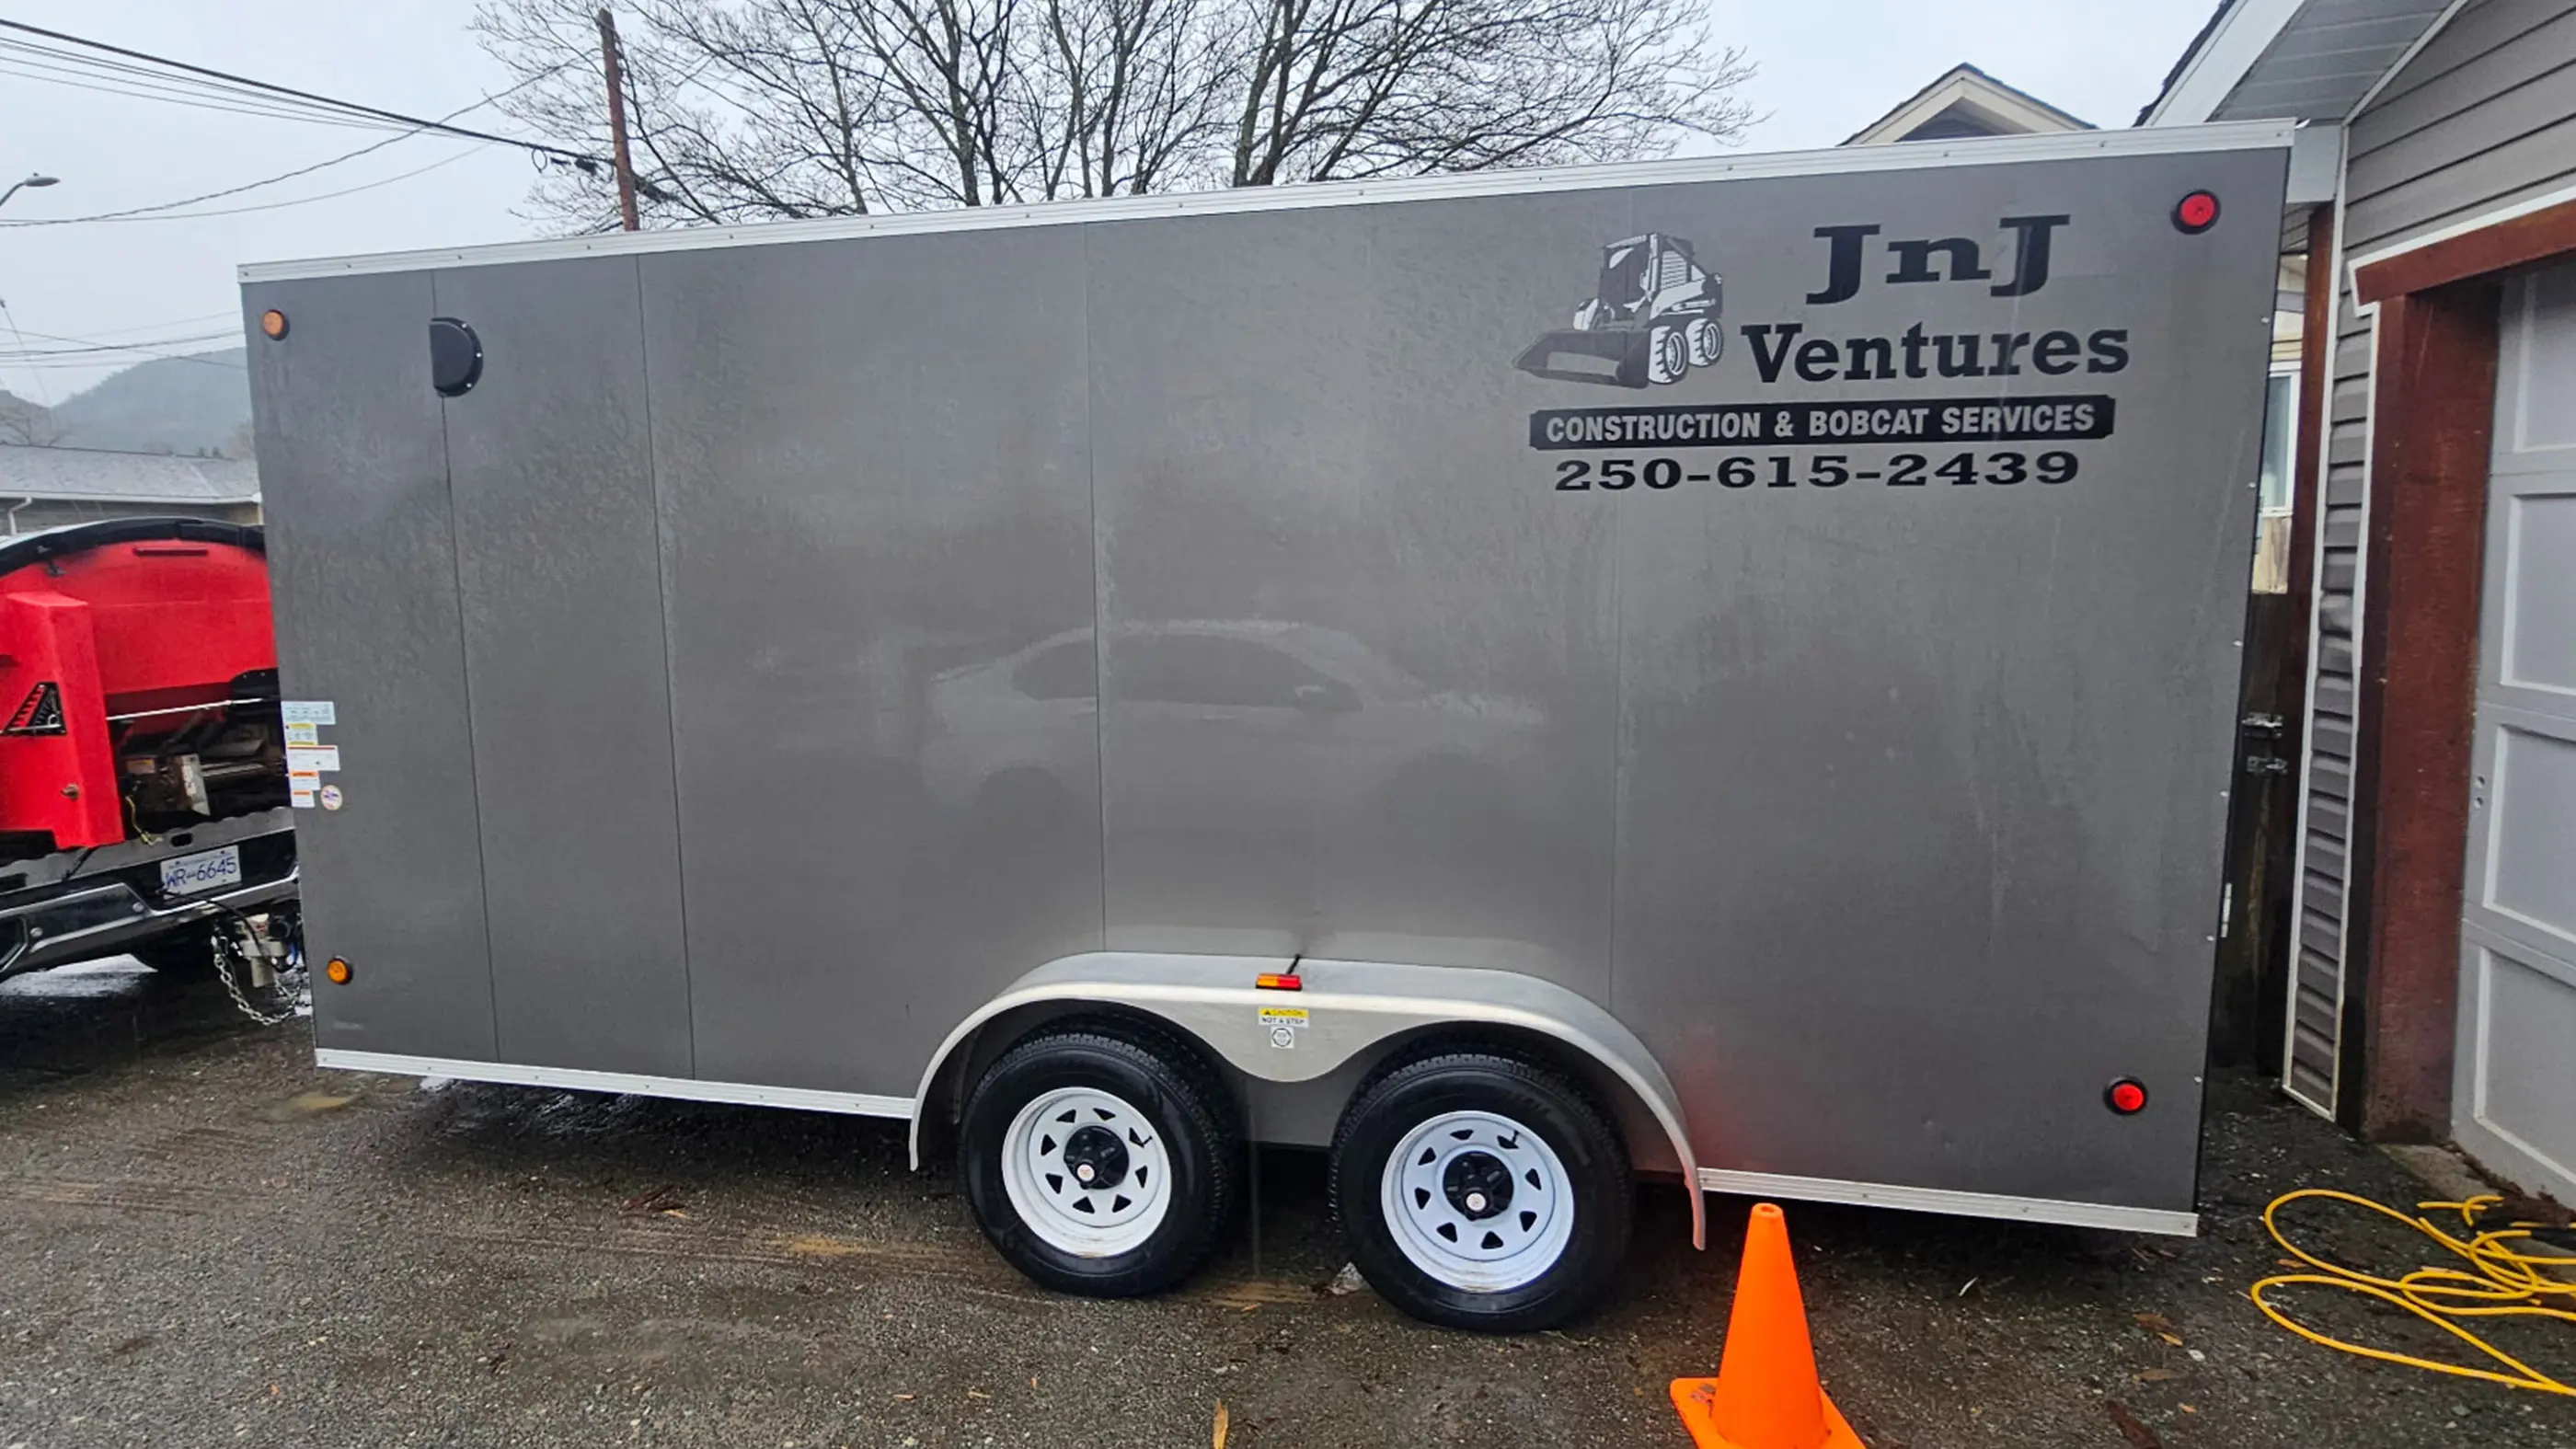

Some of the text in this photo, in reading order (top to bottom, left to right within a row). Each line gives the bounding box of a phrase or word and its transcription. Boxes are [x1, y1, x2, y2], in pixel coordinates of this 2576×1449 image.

[1805, 214, 2070, 305] JnJ
[1741, 321, 2129, 385] Ventures
[1547, 403, 2096, 443] CONSTRUCTION & BOBCAT SERVICES
[1555, 452, 2080, 491] 250-615-2439
